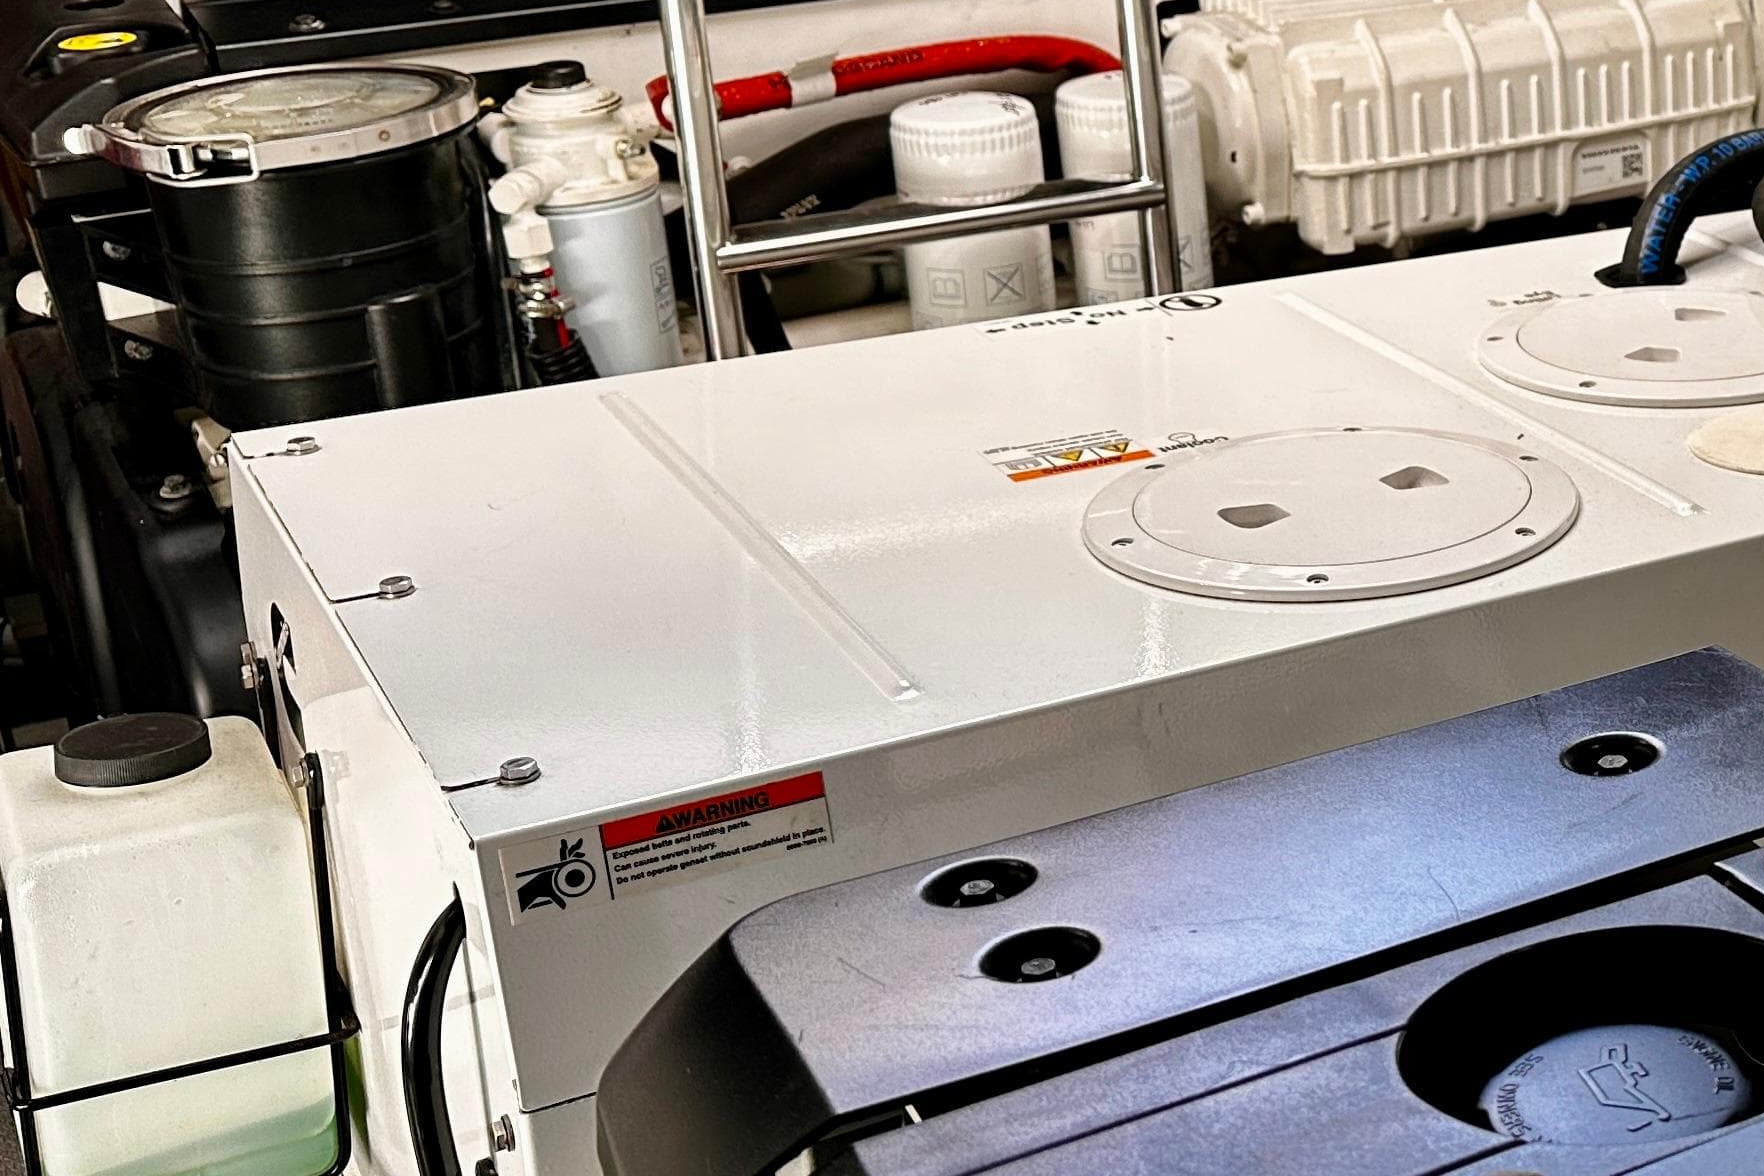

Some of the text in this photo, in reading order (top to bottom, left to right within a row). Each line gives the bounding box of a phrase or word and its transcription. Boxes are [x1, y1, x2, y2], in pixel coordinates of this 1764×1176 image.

[1636, 188, 1684, 274] WATER
[1011, 309, 1127, 331] No Step
[672, 791, 770, 828] WARNING
[612, 844, 650, 860] Exposed
[675, 833, 691, 844] and
[693, 827, 726, 842] rotating
[614, 841, 717, 872] Can cause severe injury.
[616, 875, 629, 885] Do
[630, 871, 645, 881] not
[647, 864, 678, 878] operate
[680, 857, 708, 870] genset
[710, 847, 740, 861] without
[793, 831, 801, 842] in
[802, 826, 825, 839] place.
